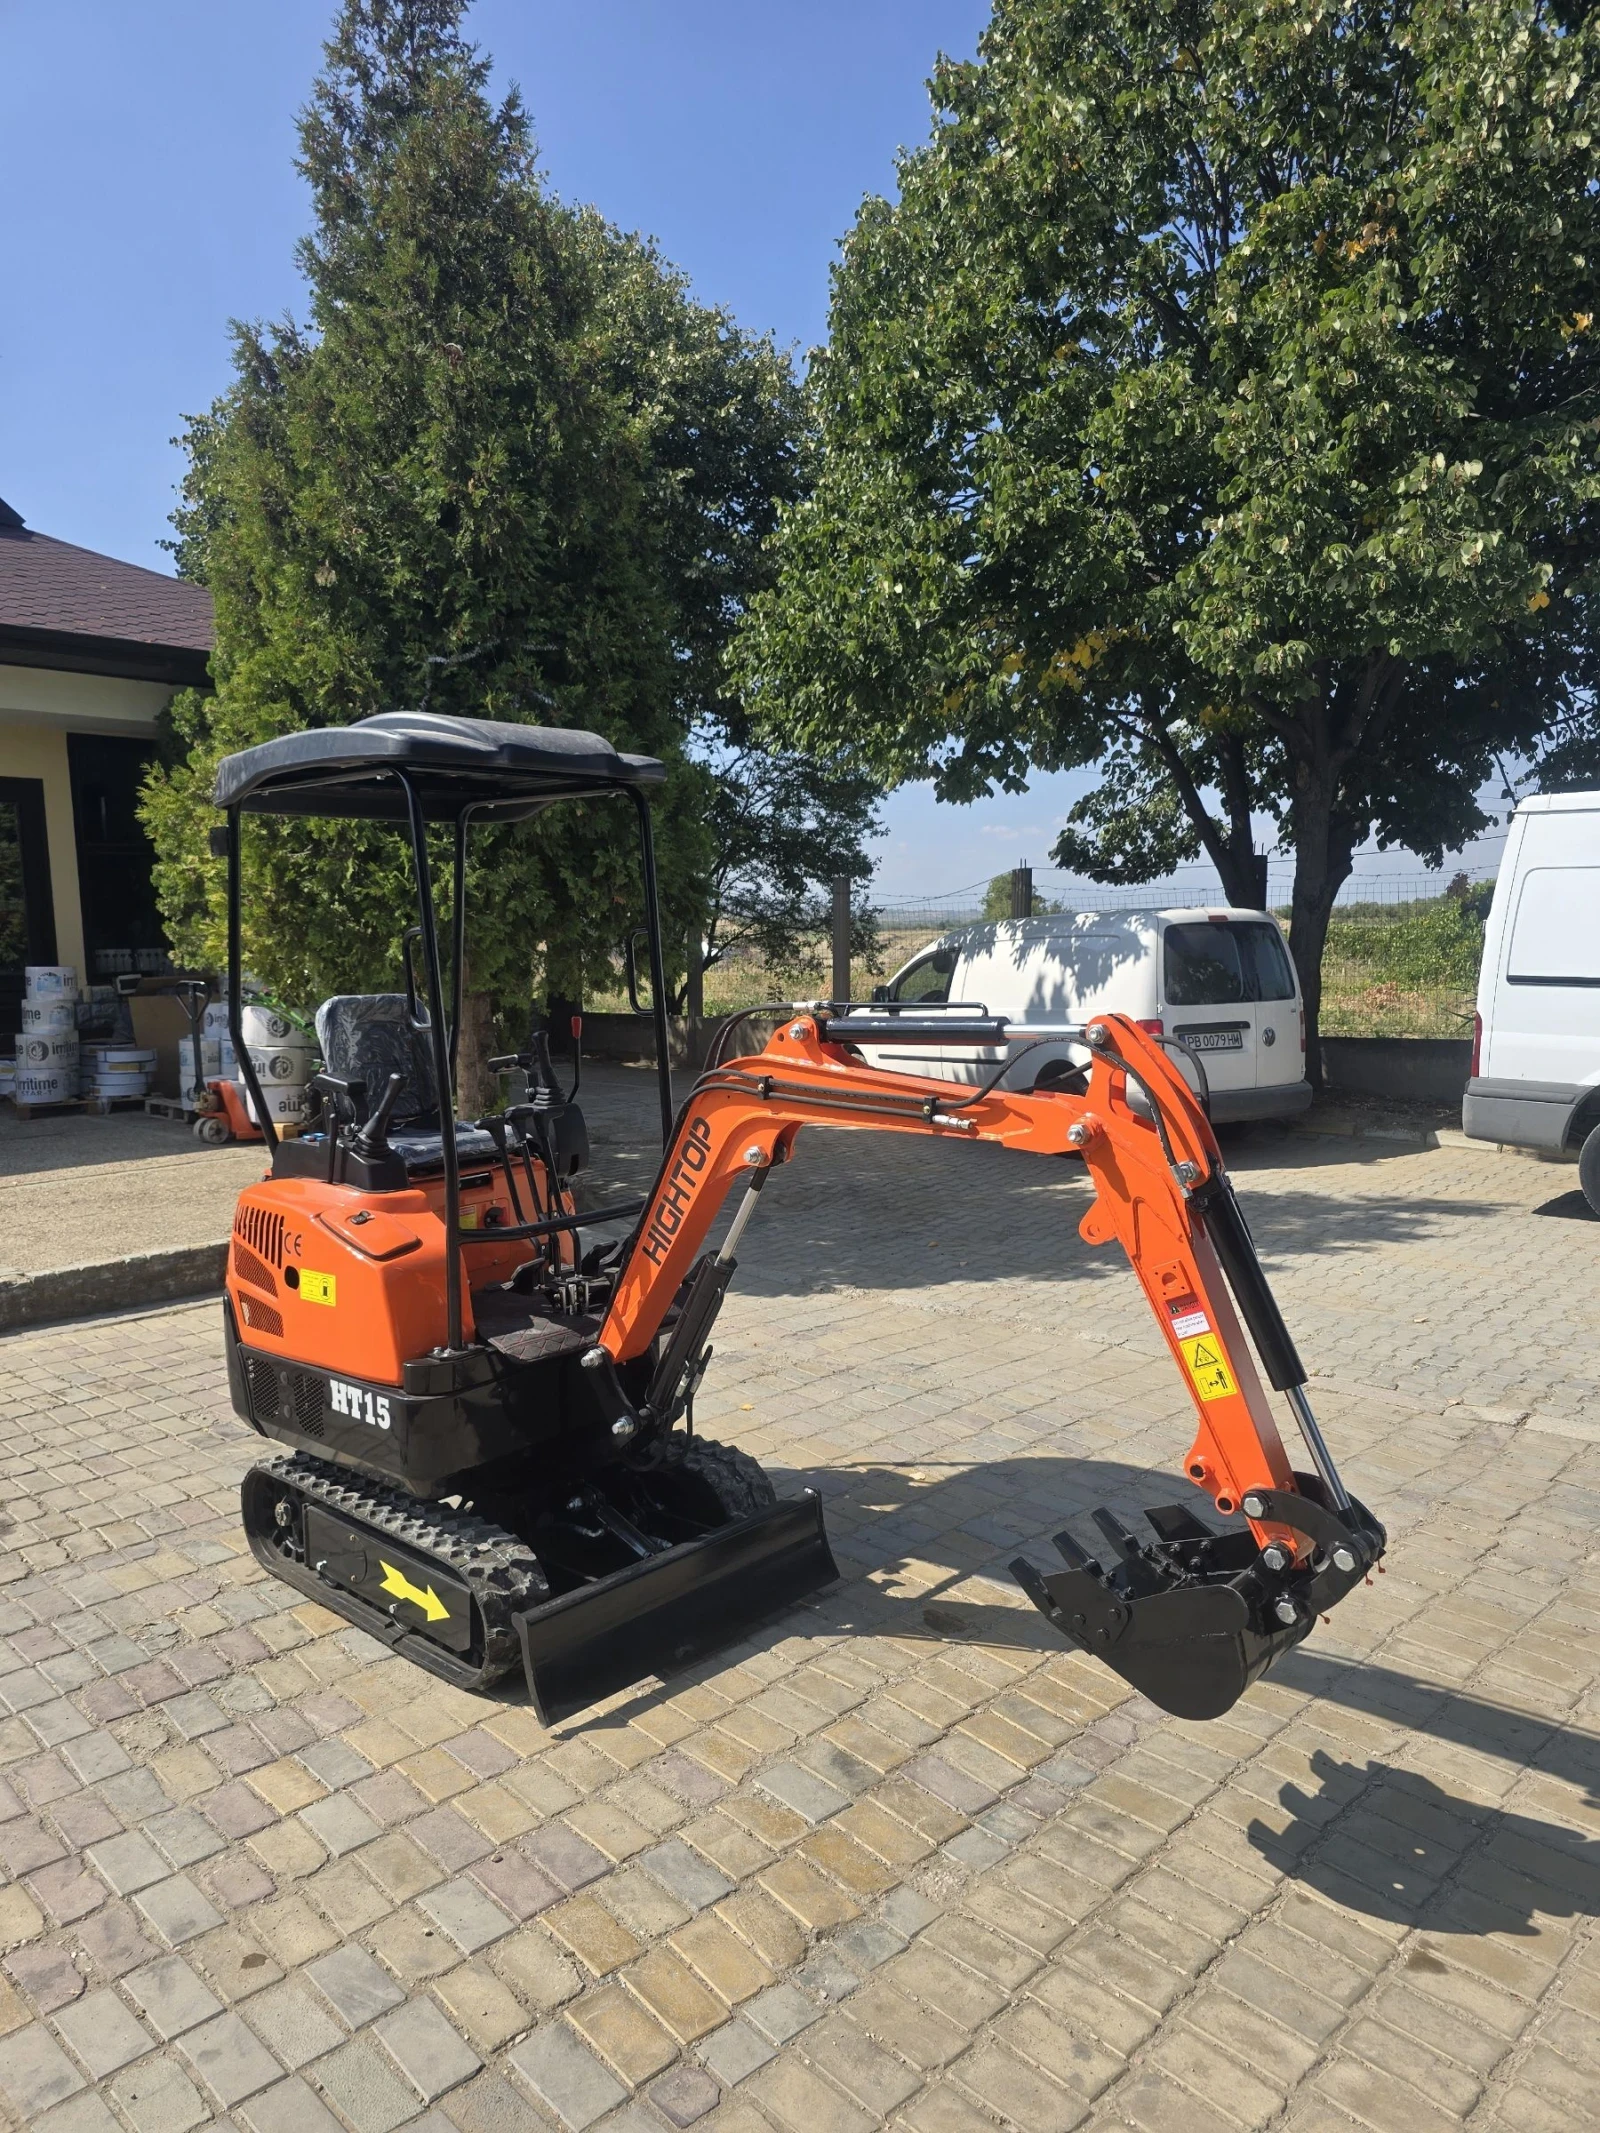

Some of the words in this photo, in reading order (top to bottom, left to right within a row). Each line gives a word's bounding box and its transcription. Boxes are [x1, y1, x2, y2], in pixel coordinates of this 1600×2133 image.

[1187, 1036, 1201, 1047] PB
[1203, 1034, 1226, 1046] 0079
[642, 1116, 712, 1266] HIGHTOP
[330, 1379, 391, 1430] HT15
